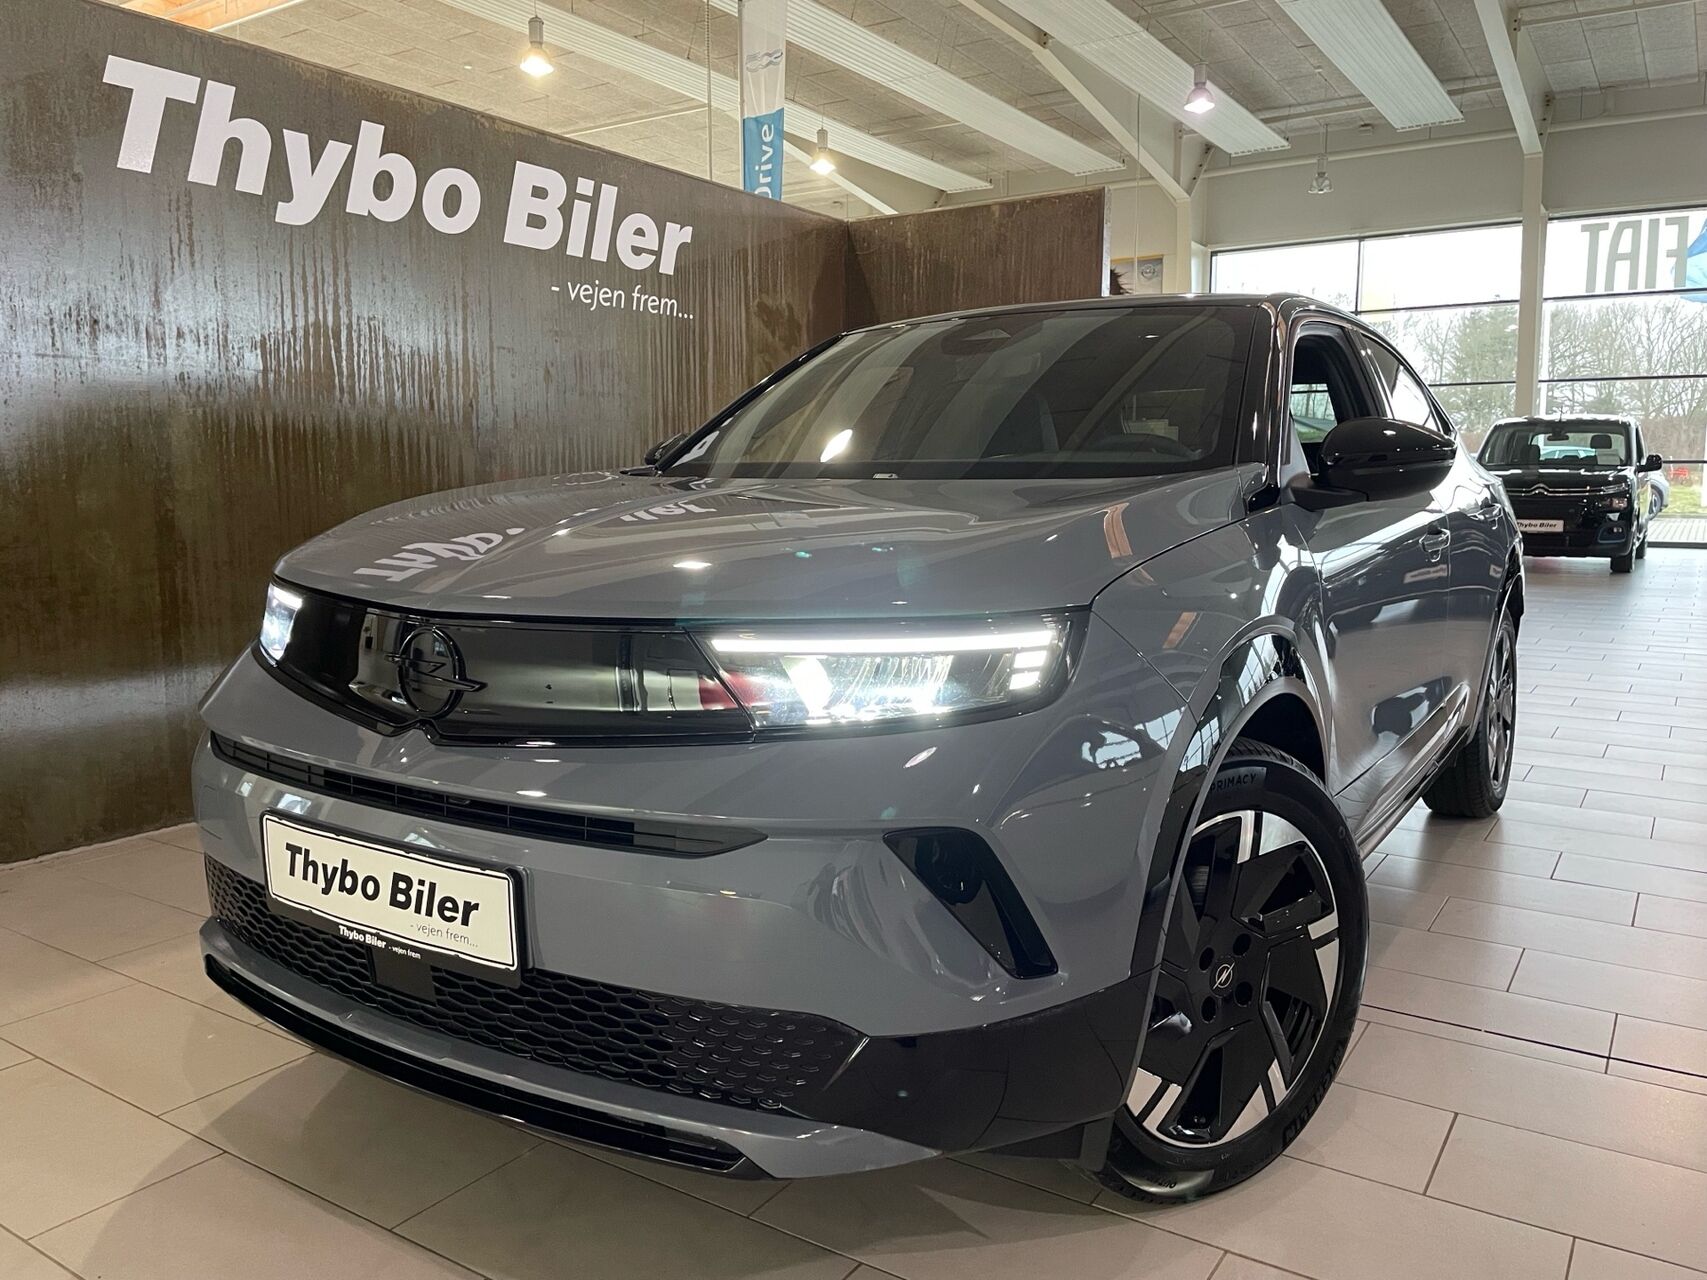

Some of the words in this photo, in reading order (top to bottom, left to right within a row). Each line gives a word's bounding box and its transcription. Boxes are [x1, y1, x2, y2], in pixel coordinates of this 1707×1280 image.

[102, 54, 481, 234] Thybo
[503, 160, 692, 275] Biler
[567, 280, 625, 311] vejen
[285, 842, 381, 901] Thybo
[389, 871, 480, 927] Biler
[338, 925, 365, 942] Thybo
[365, 935, 387, 949] Biler
[416, 922, 443, 939] vejen
